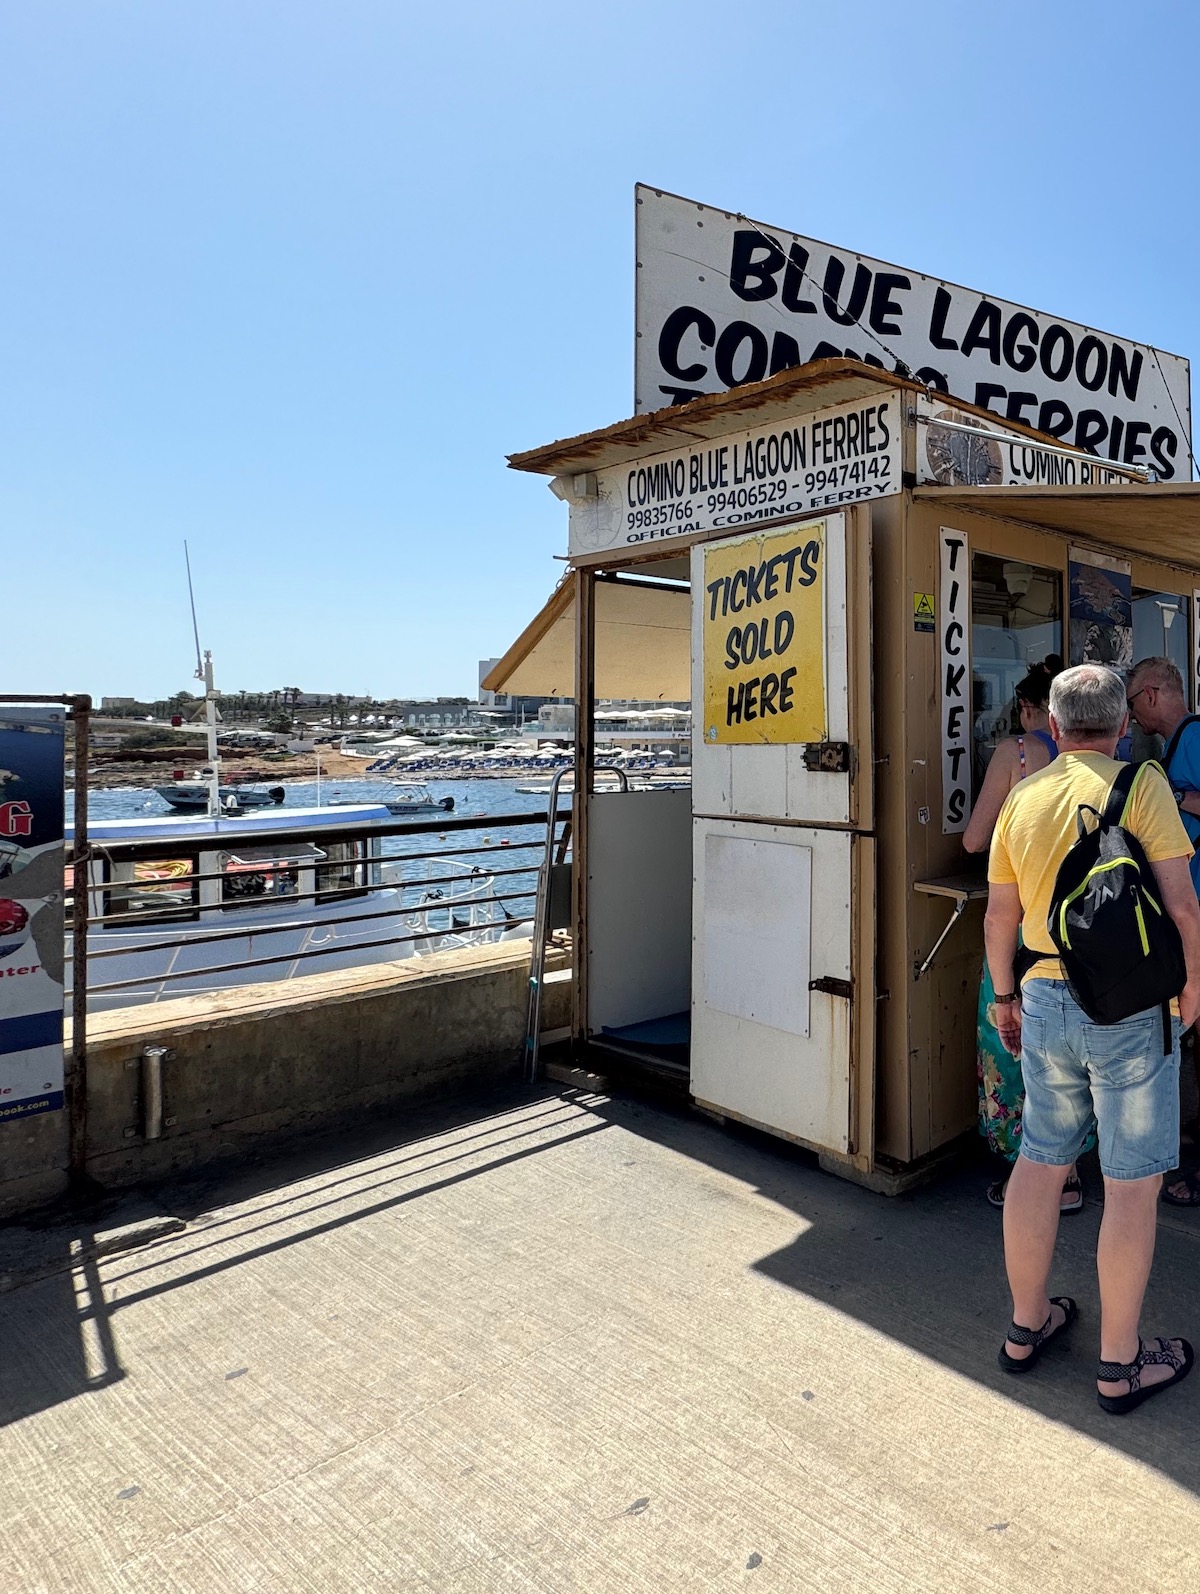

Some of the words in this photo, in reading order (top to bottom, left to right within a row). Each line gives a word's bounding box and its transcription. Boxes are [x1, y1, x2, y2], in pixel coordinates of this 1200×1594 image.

[729, 230, 911, 335] BLUE
[929, 286, 1143, 402] LAGOON
[627, 457, 685, 508] COMINO
[689, 445, 728, 494] BLUE
[734, 426, 807, 485] LAGOON
[812, 403, 890, 467] FERRIES
[627, 499, 693, 530] 99835766
[707, 479, 787, 513] 99406529
[805, 455, 891, 494] 99474142
[626, 521, 706, 543] OFFICIAL
[712, 501, 802, 527] COMINO
[810, 481, 892, 508] FERRY
[707, 540, 819, 620] TICKETS
[724, 610, 794, 670] SOLD
[726, 667, 797, 726] HERE
[945, 538, 967, 824] TICKETS
